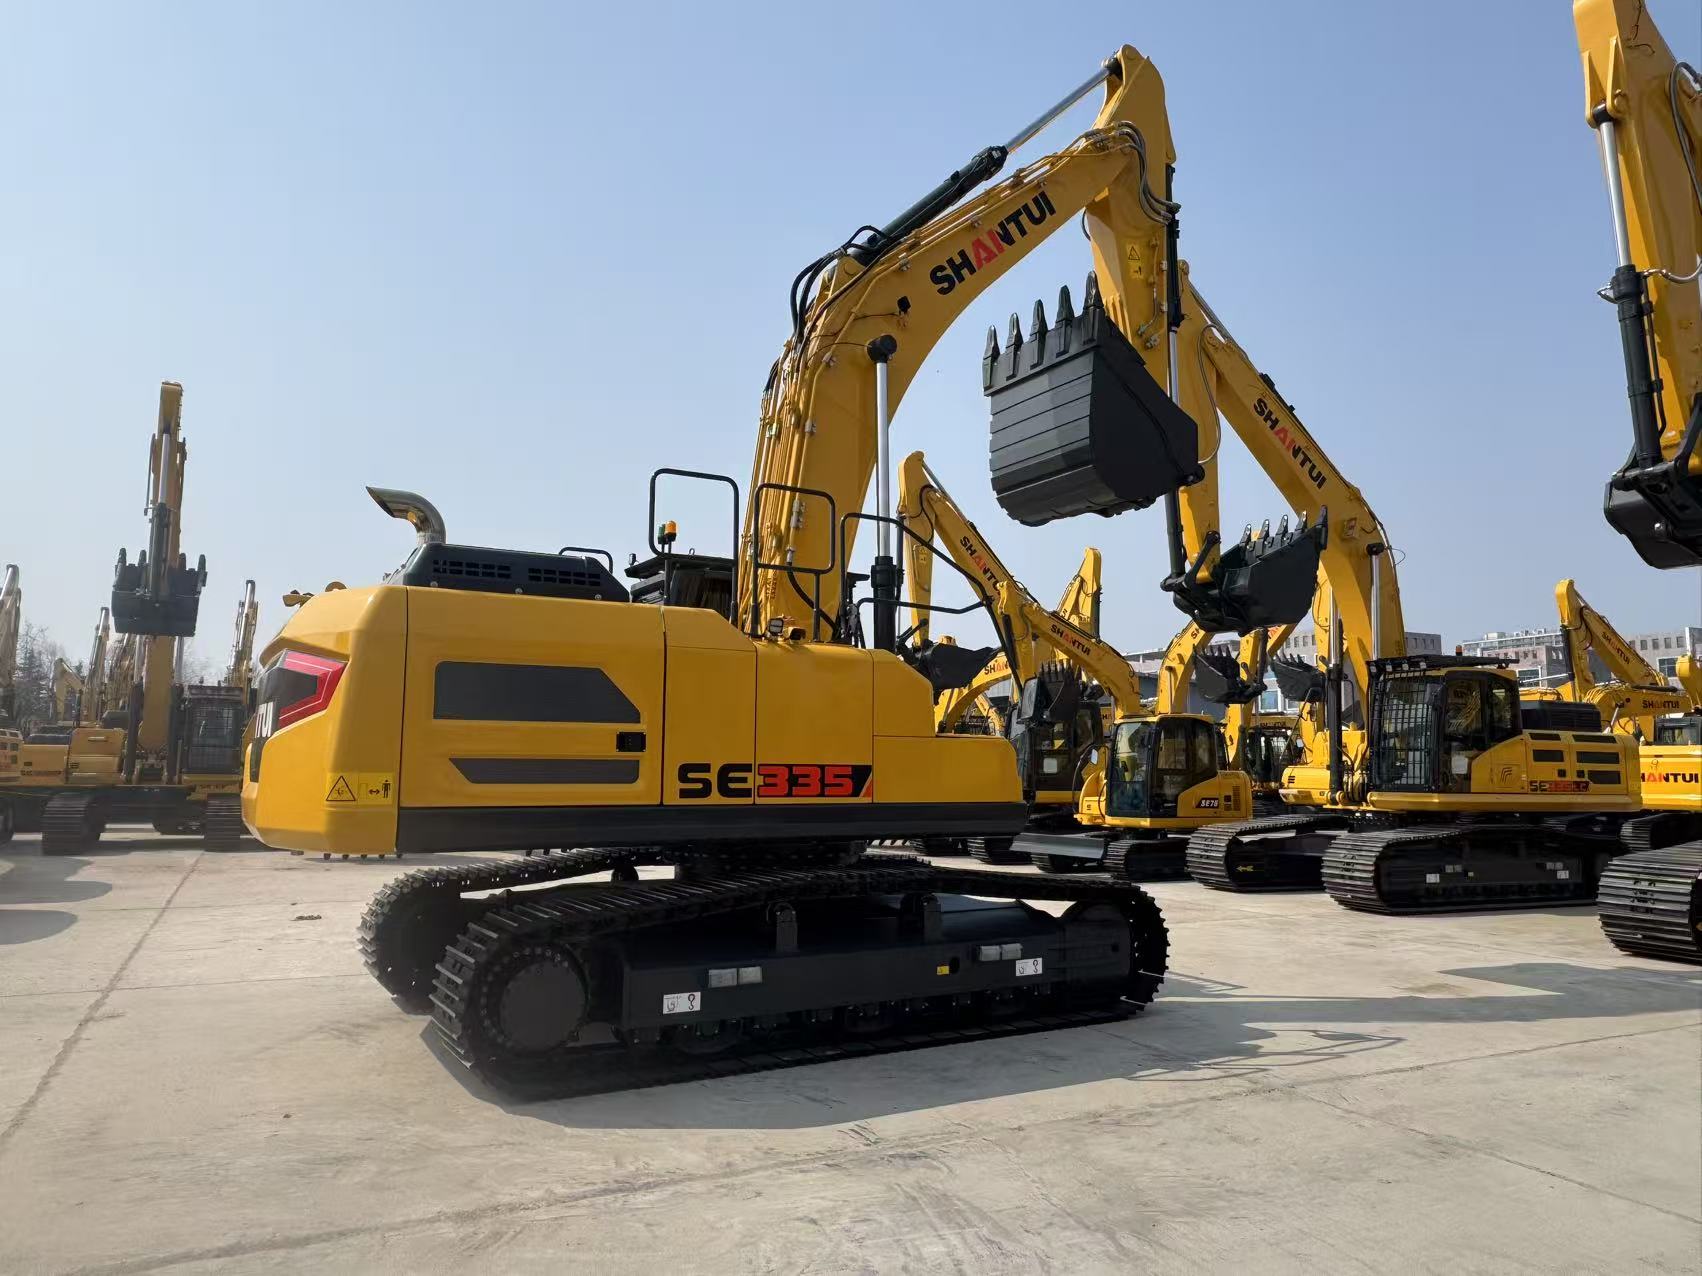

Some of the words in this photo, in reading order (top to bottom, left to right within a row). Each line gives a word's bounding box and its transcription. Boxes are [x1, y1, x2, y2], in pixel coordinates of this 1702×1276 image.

[930, 191, 1056, 295] SHANTUI
[1253, 398, 1326, 489] SHANTUI
[960, 535, 1001, 597] SHANTU
[1050, 624, 1091, 655] SHANTUI
[678, 763, 853, 798] SE335
[1641, 772, 1699, 783] HANTUI
